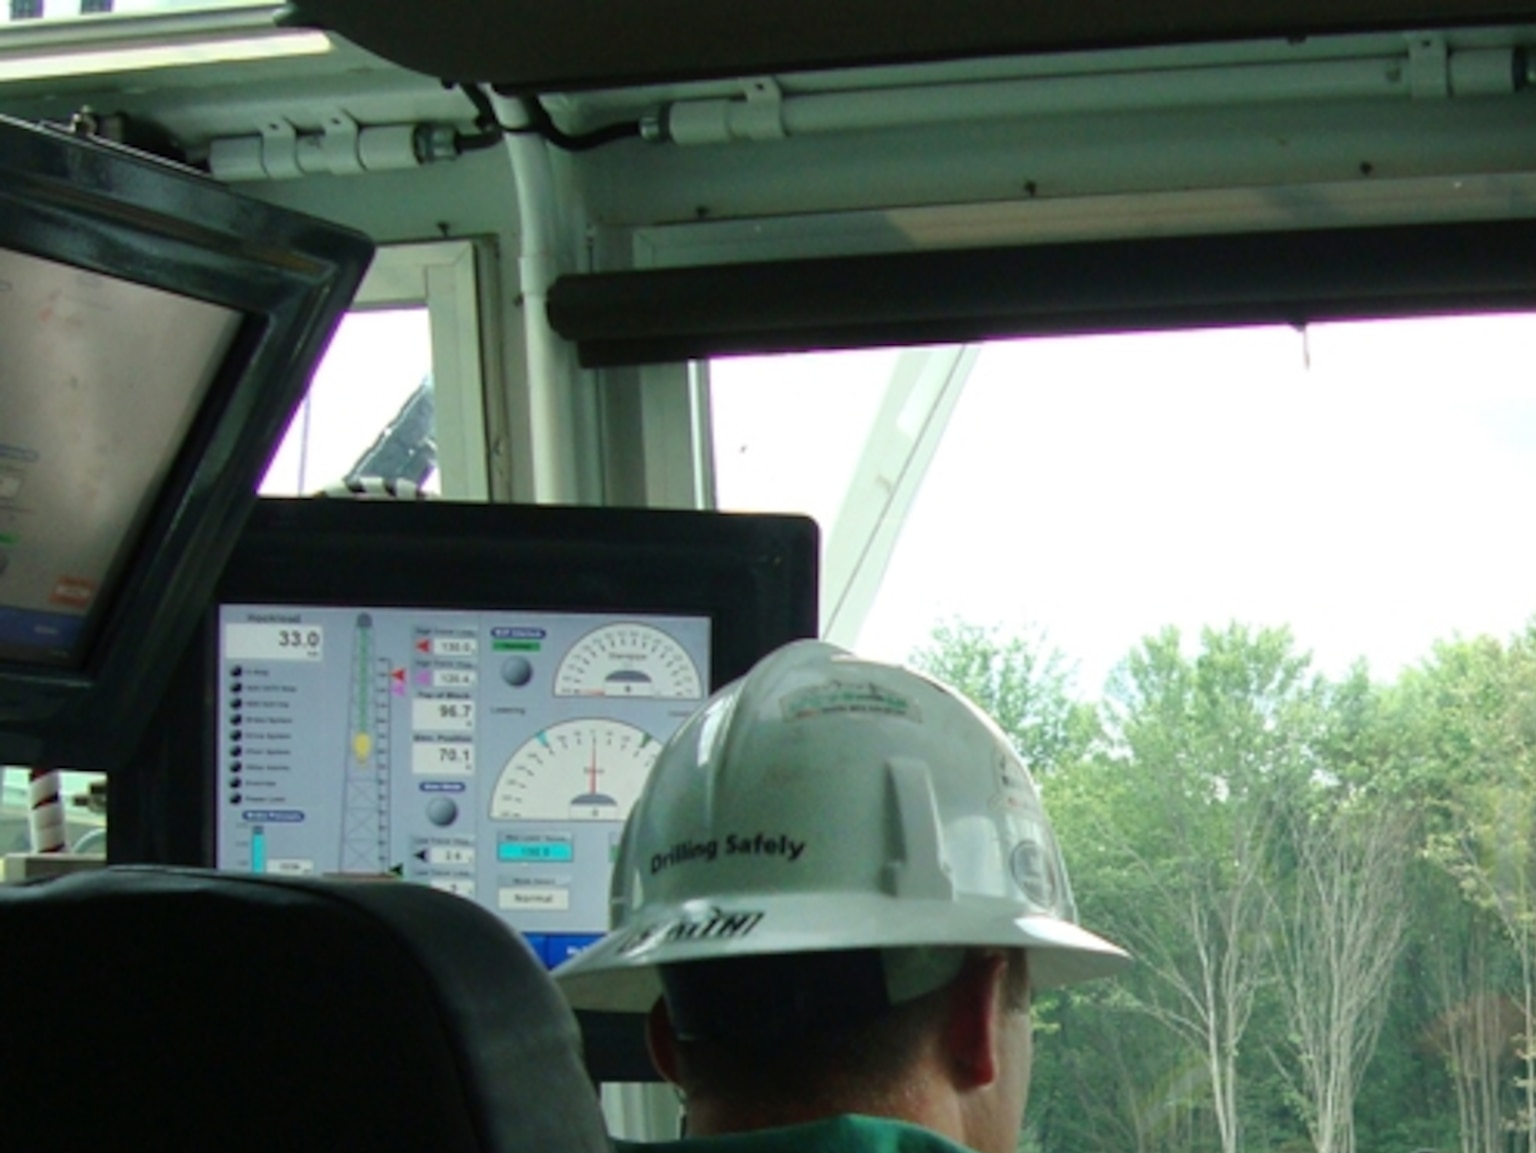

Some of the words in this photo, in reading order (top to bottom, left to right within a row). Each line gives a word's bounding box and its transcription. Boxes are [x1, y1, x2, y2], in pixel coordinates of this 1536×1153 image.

[278, 629, 320, 649] 33.0
[650, 839, 718, 875] Drilling
[725, 832, 805, 862] Safely
